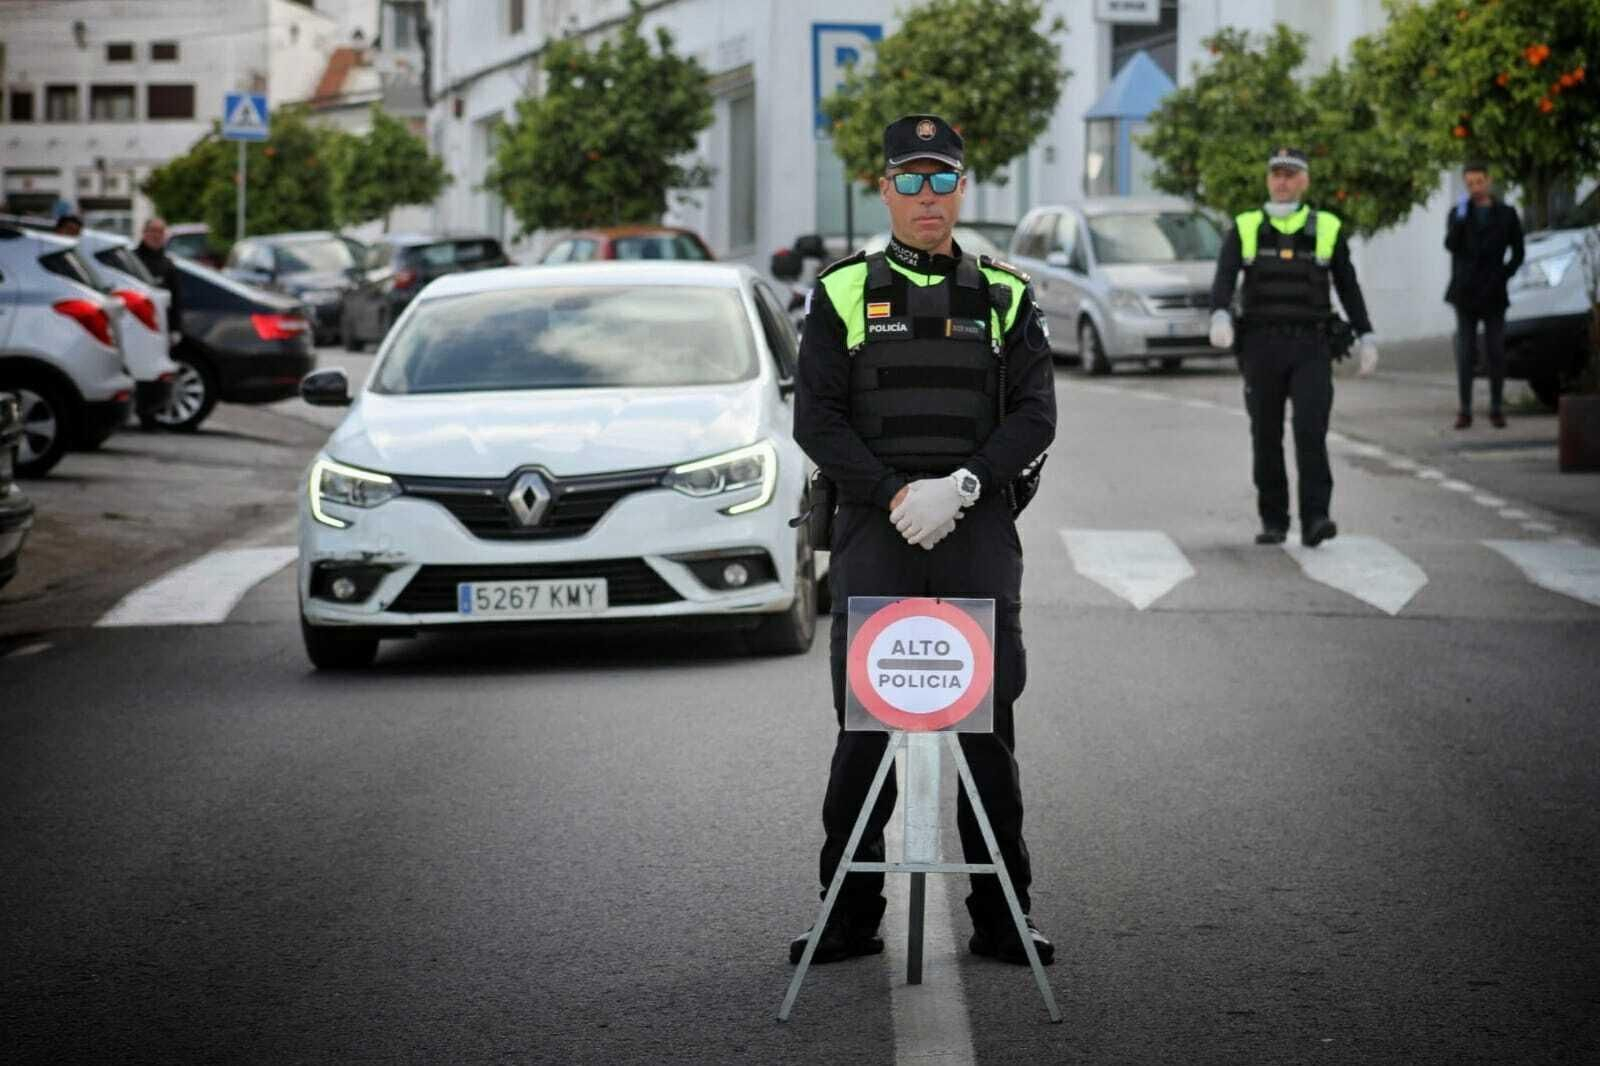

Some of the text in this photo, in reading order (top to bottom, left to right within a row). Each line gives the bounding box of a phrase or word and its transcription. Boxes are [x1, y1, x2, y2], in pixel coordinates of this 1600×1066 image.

[820, 31, 878, 100] P
[868, 321, 908, 333] POLICÍA
[476, 583, 597, 611] 5267 KMY
[891, 640, 950, 656] ALTO
[879, 674, 962, 689] POLICIA
